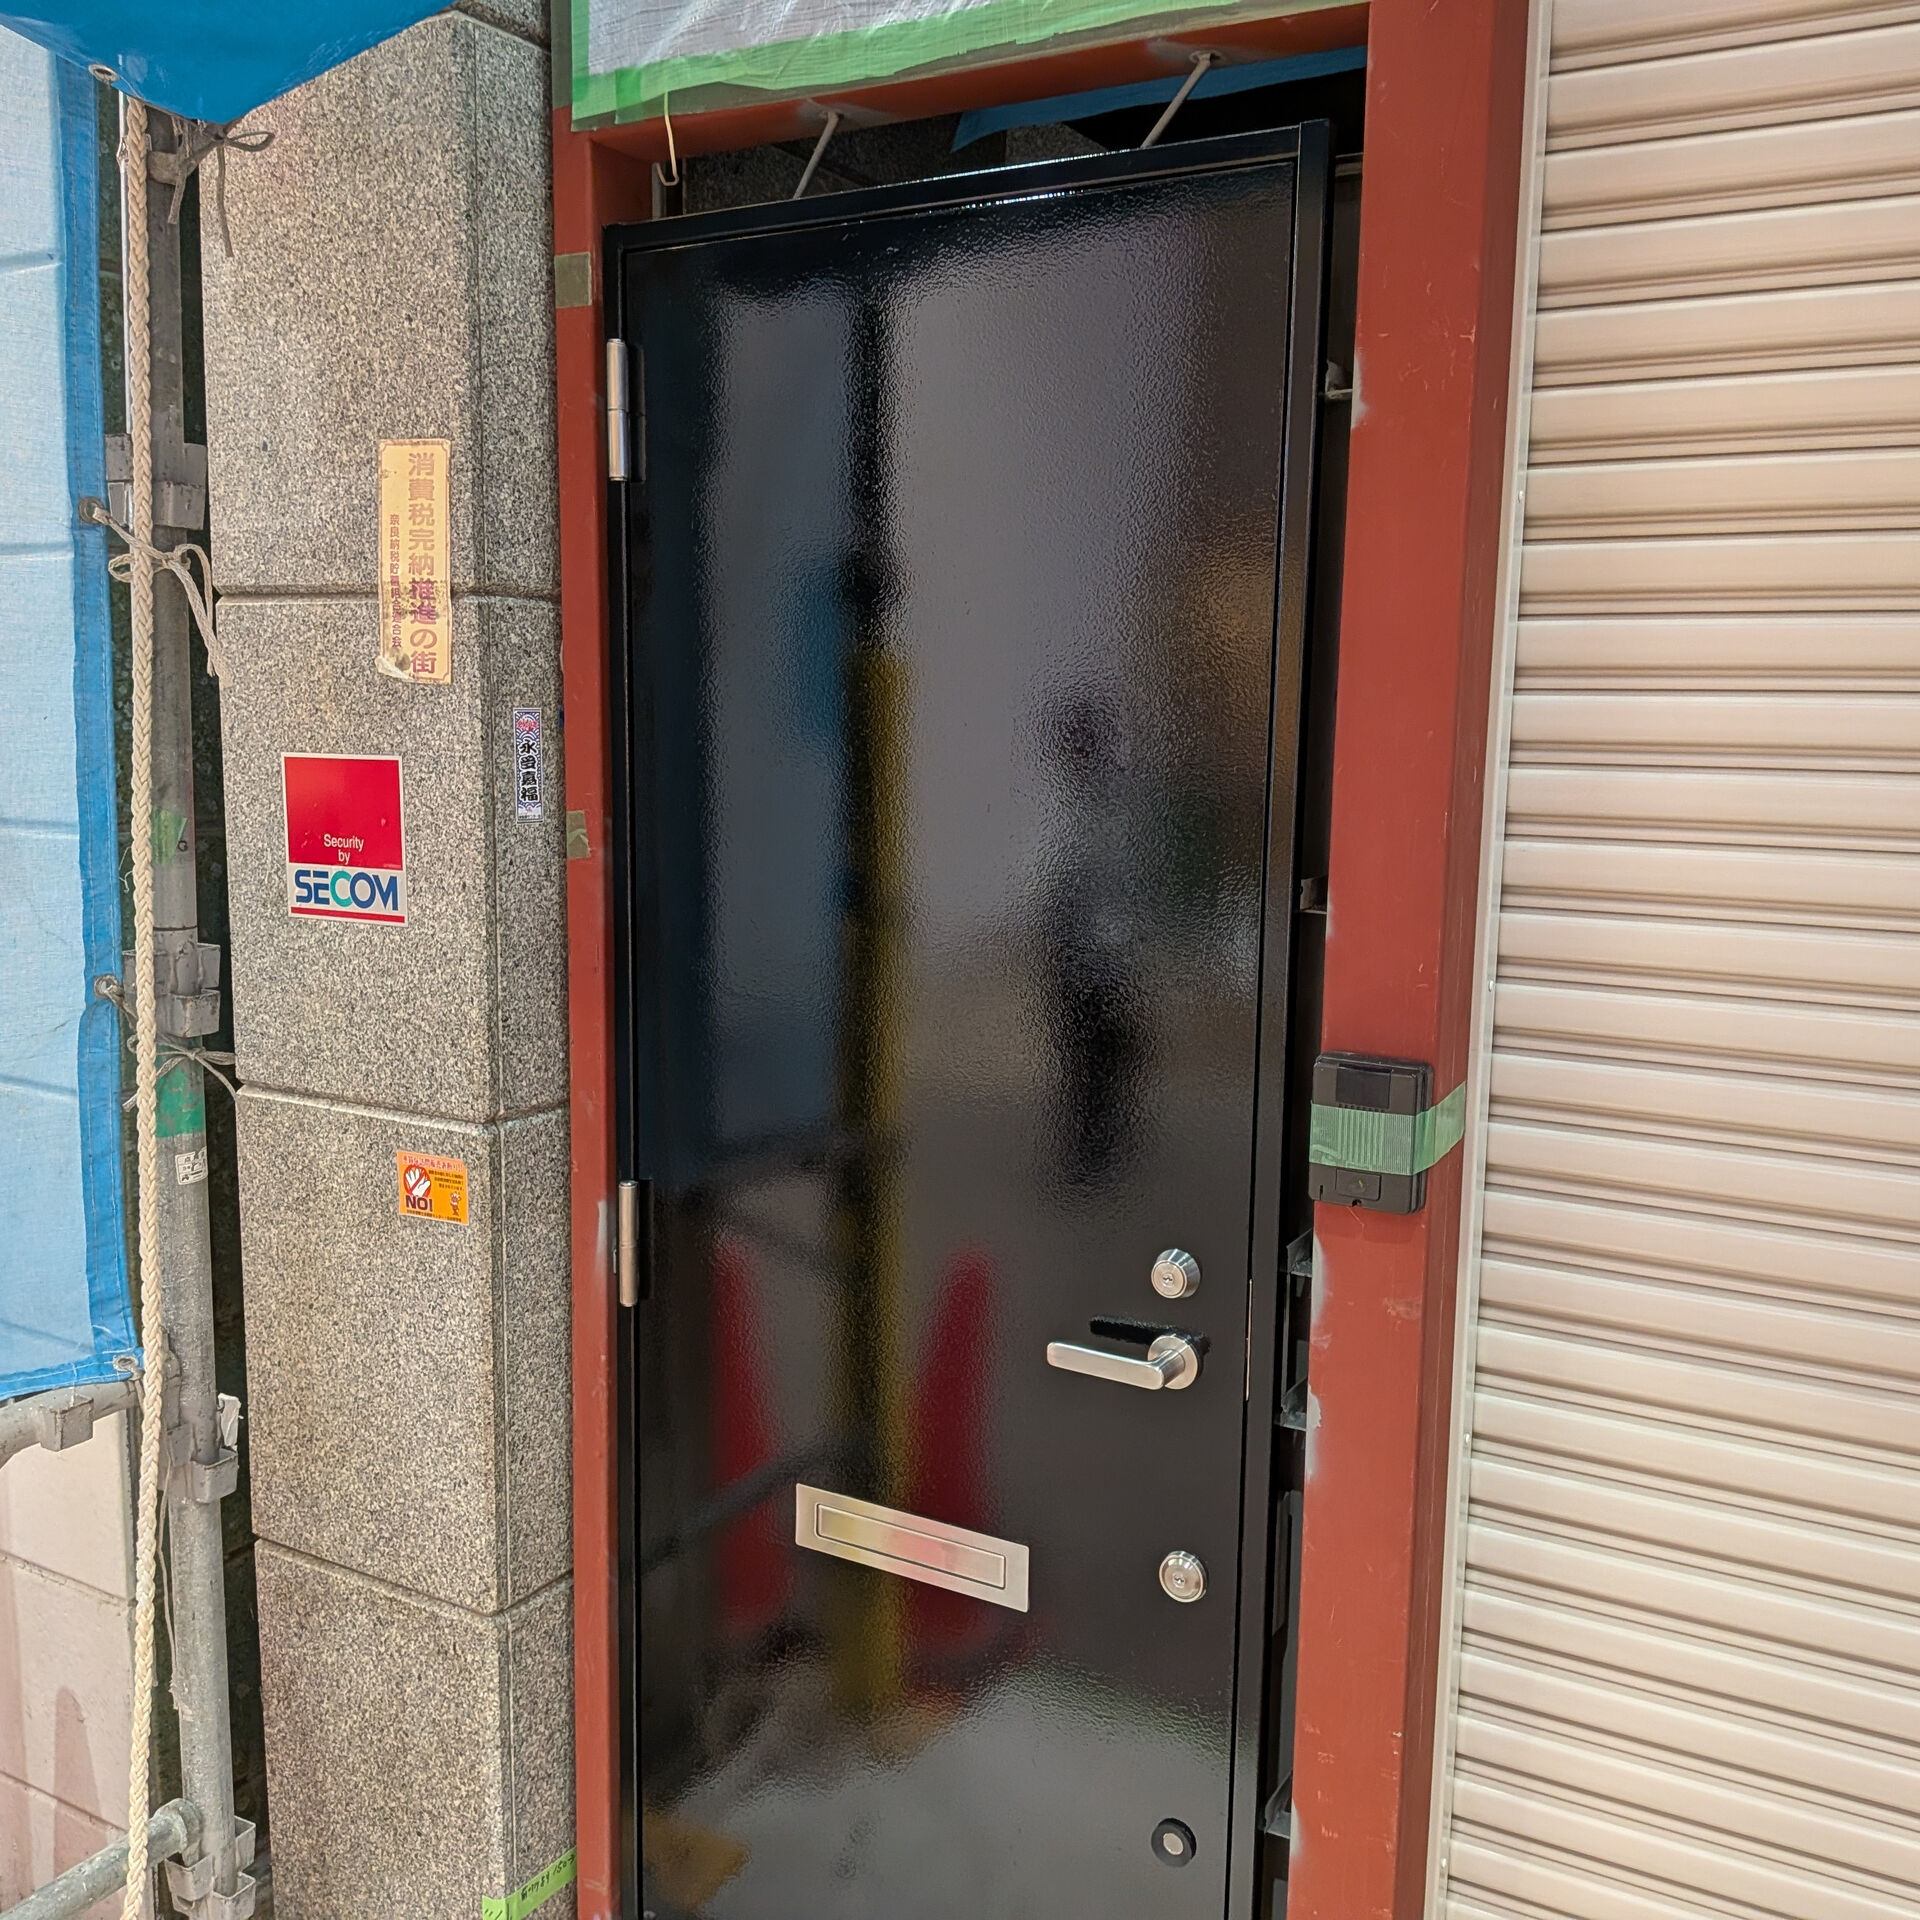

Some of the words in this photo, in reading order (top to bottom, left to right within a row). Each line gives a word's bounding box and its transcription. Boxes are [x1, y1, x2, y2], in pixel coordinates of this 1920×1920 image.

[408, 452, 438, 674] 消費税完納推進の街
[323, 834, 364, 851] Security
[338, 849, 350, 865] by
[295, 869, 399, 911] SECOM
[405, 1195, 433, 1212] NO!
